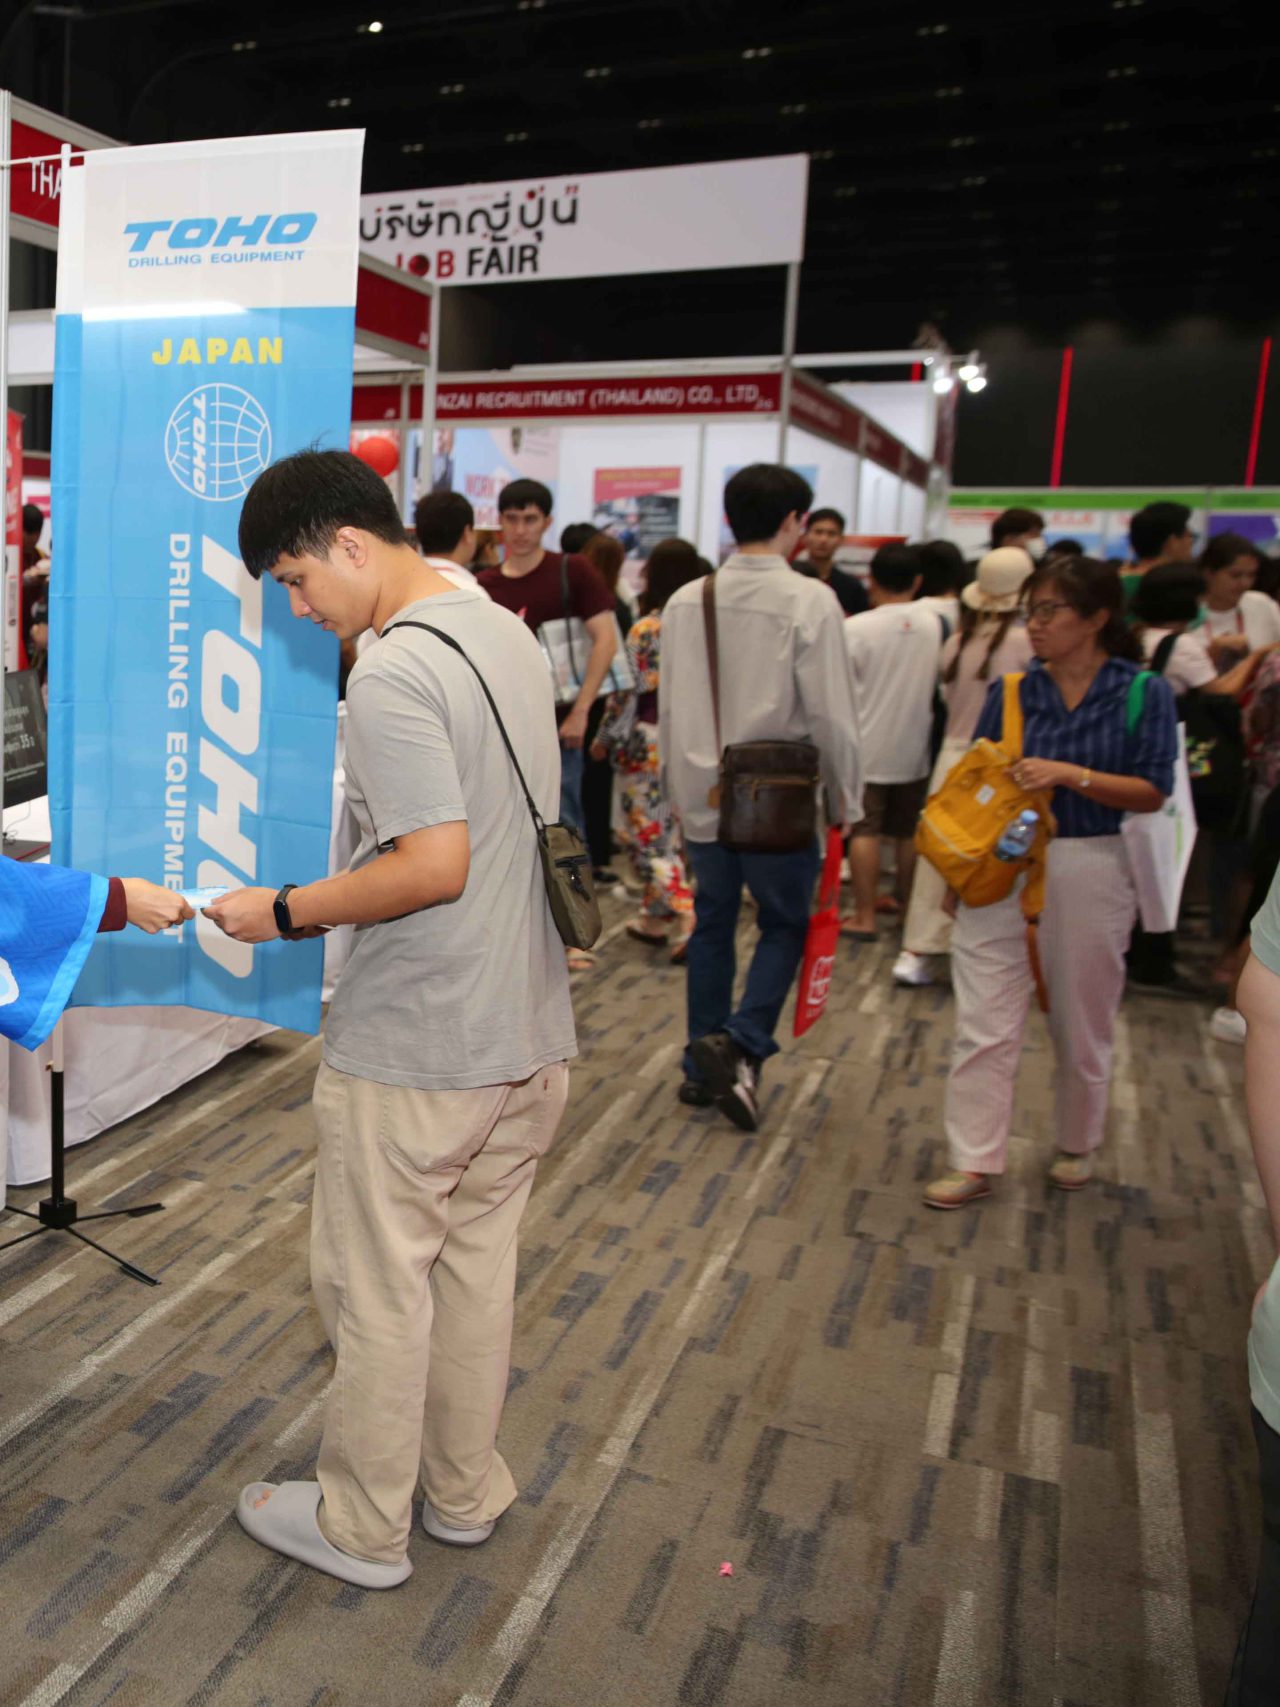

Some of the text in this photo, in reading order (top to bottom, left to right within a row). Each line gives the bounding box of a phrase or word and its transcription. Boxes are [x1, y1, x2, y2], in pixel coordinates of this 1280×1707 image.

[124, 212, 318, 253] TOHO
[128, 250, 306, 268] DRILLING EQUIPMENT
[467, 245, 539, 278] FAIR
[152, 337, 283, 364] JAPAN
[436, 391, 472, 411] NZAI
[475, 388, 585, 409] RECRUITMENT
[589, 384, 683, 408] (THAILAND)
[192, 392, 207, 494] TOHO
[162, 533, 191, 944] DRILLING EQUIPMET
